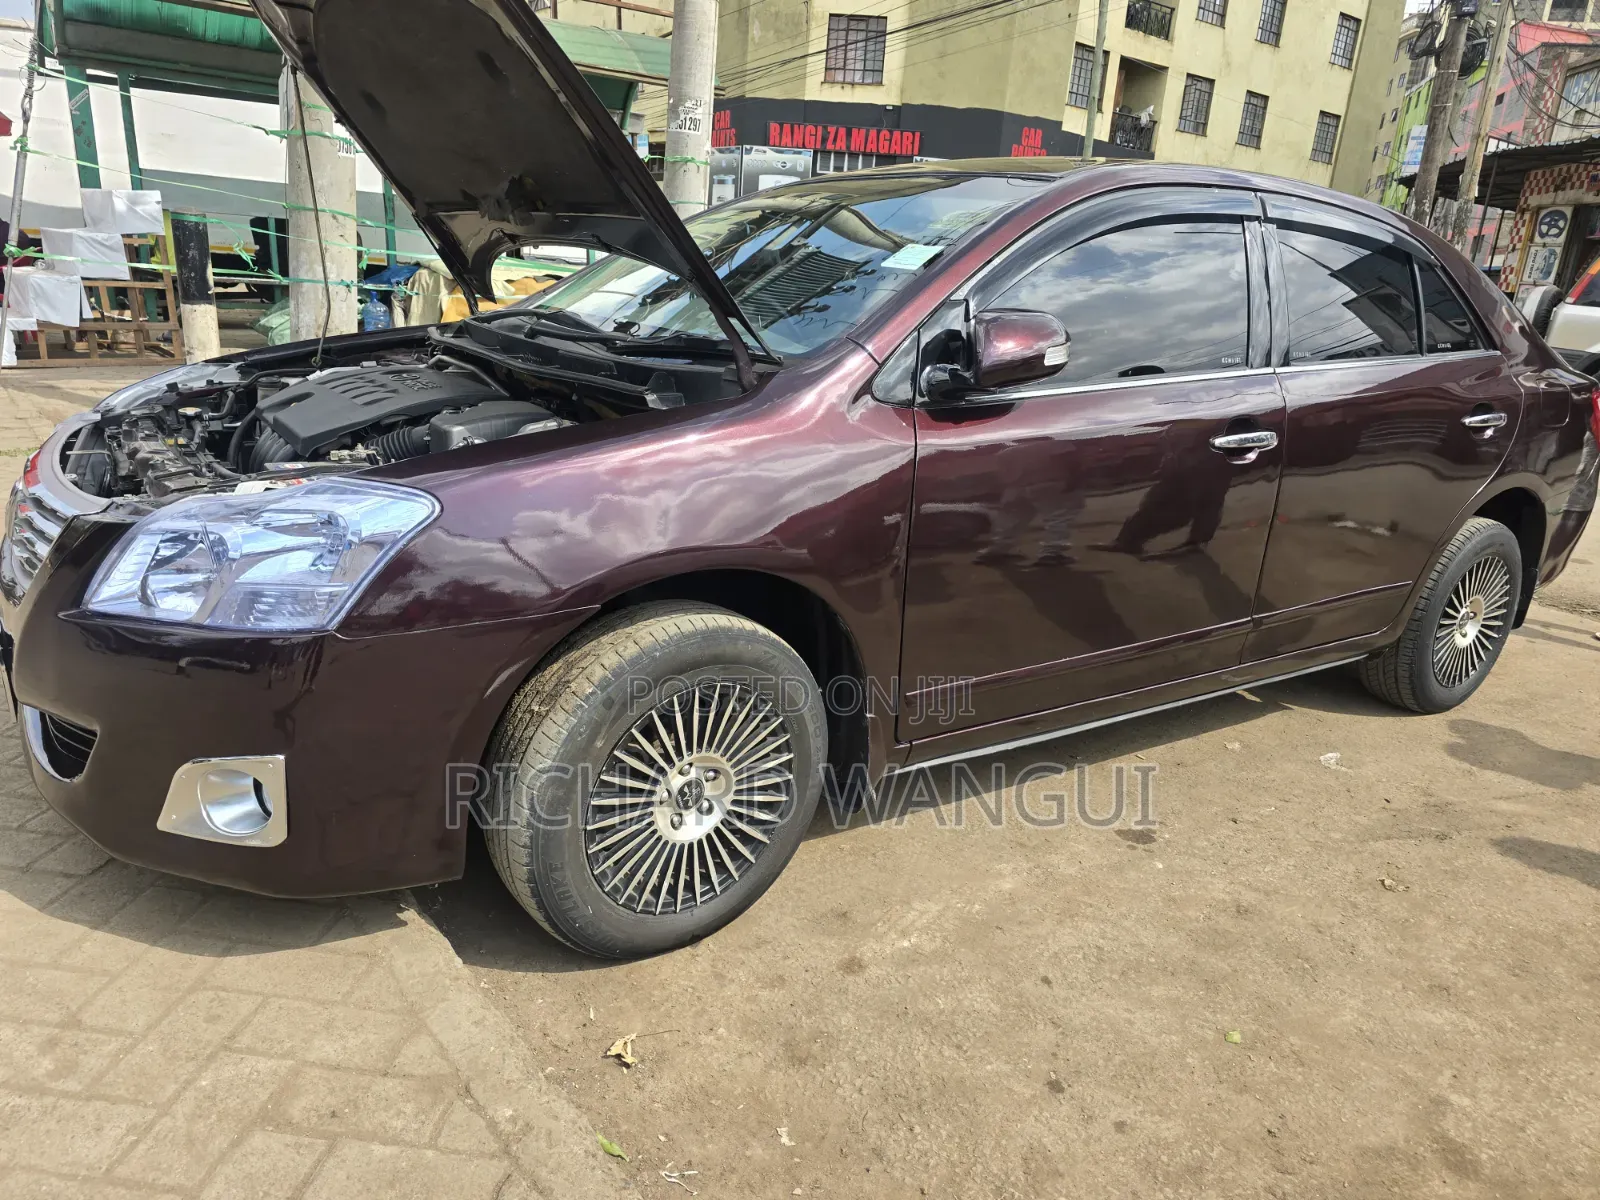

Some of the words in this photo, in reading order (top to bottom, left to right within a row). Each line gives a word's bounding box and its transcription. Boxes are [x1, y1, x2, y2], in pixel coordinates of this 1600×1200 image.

[714, 110, 731, 130] CAR
[711, 128, 736, 148] AINTS
[769, 122, 823, 149] RANGI
[826, 126, 847, 151] ZA
[851, 127, 921, 156] MAGARI
[1021, 126, 1042, 148] CAR
